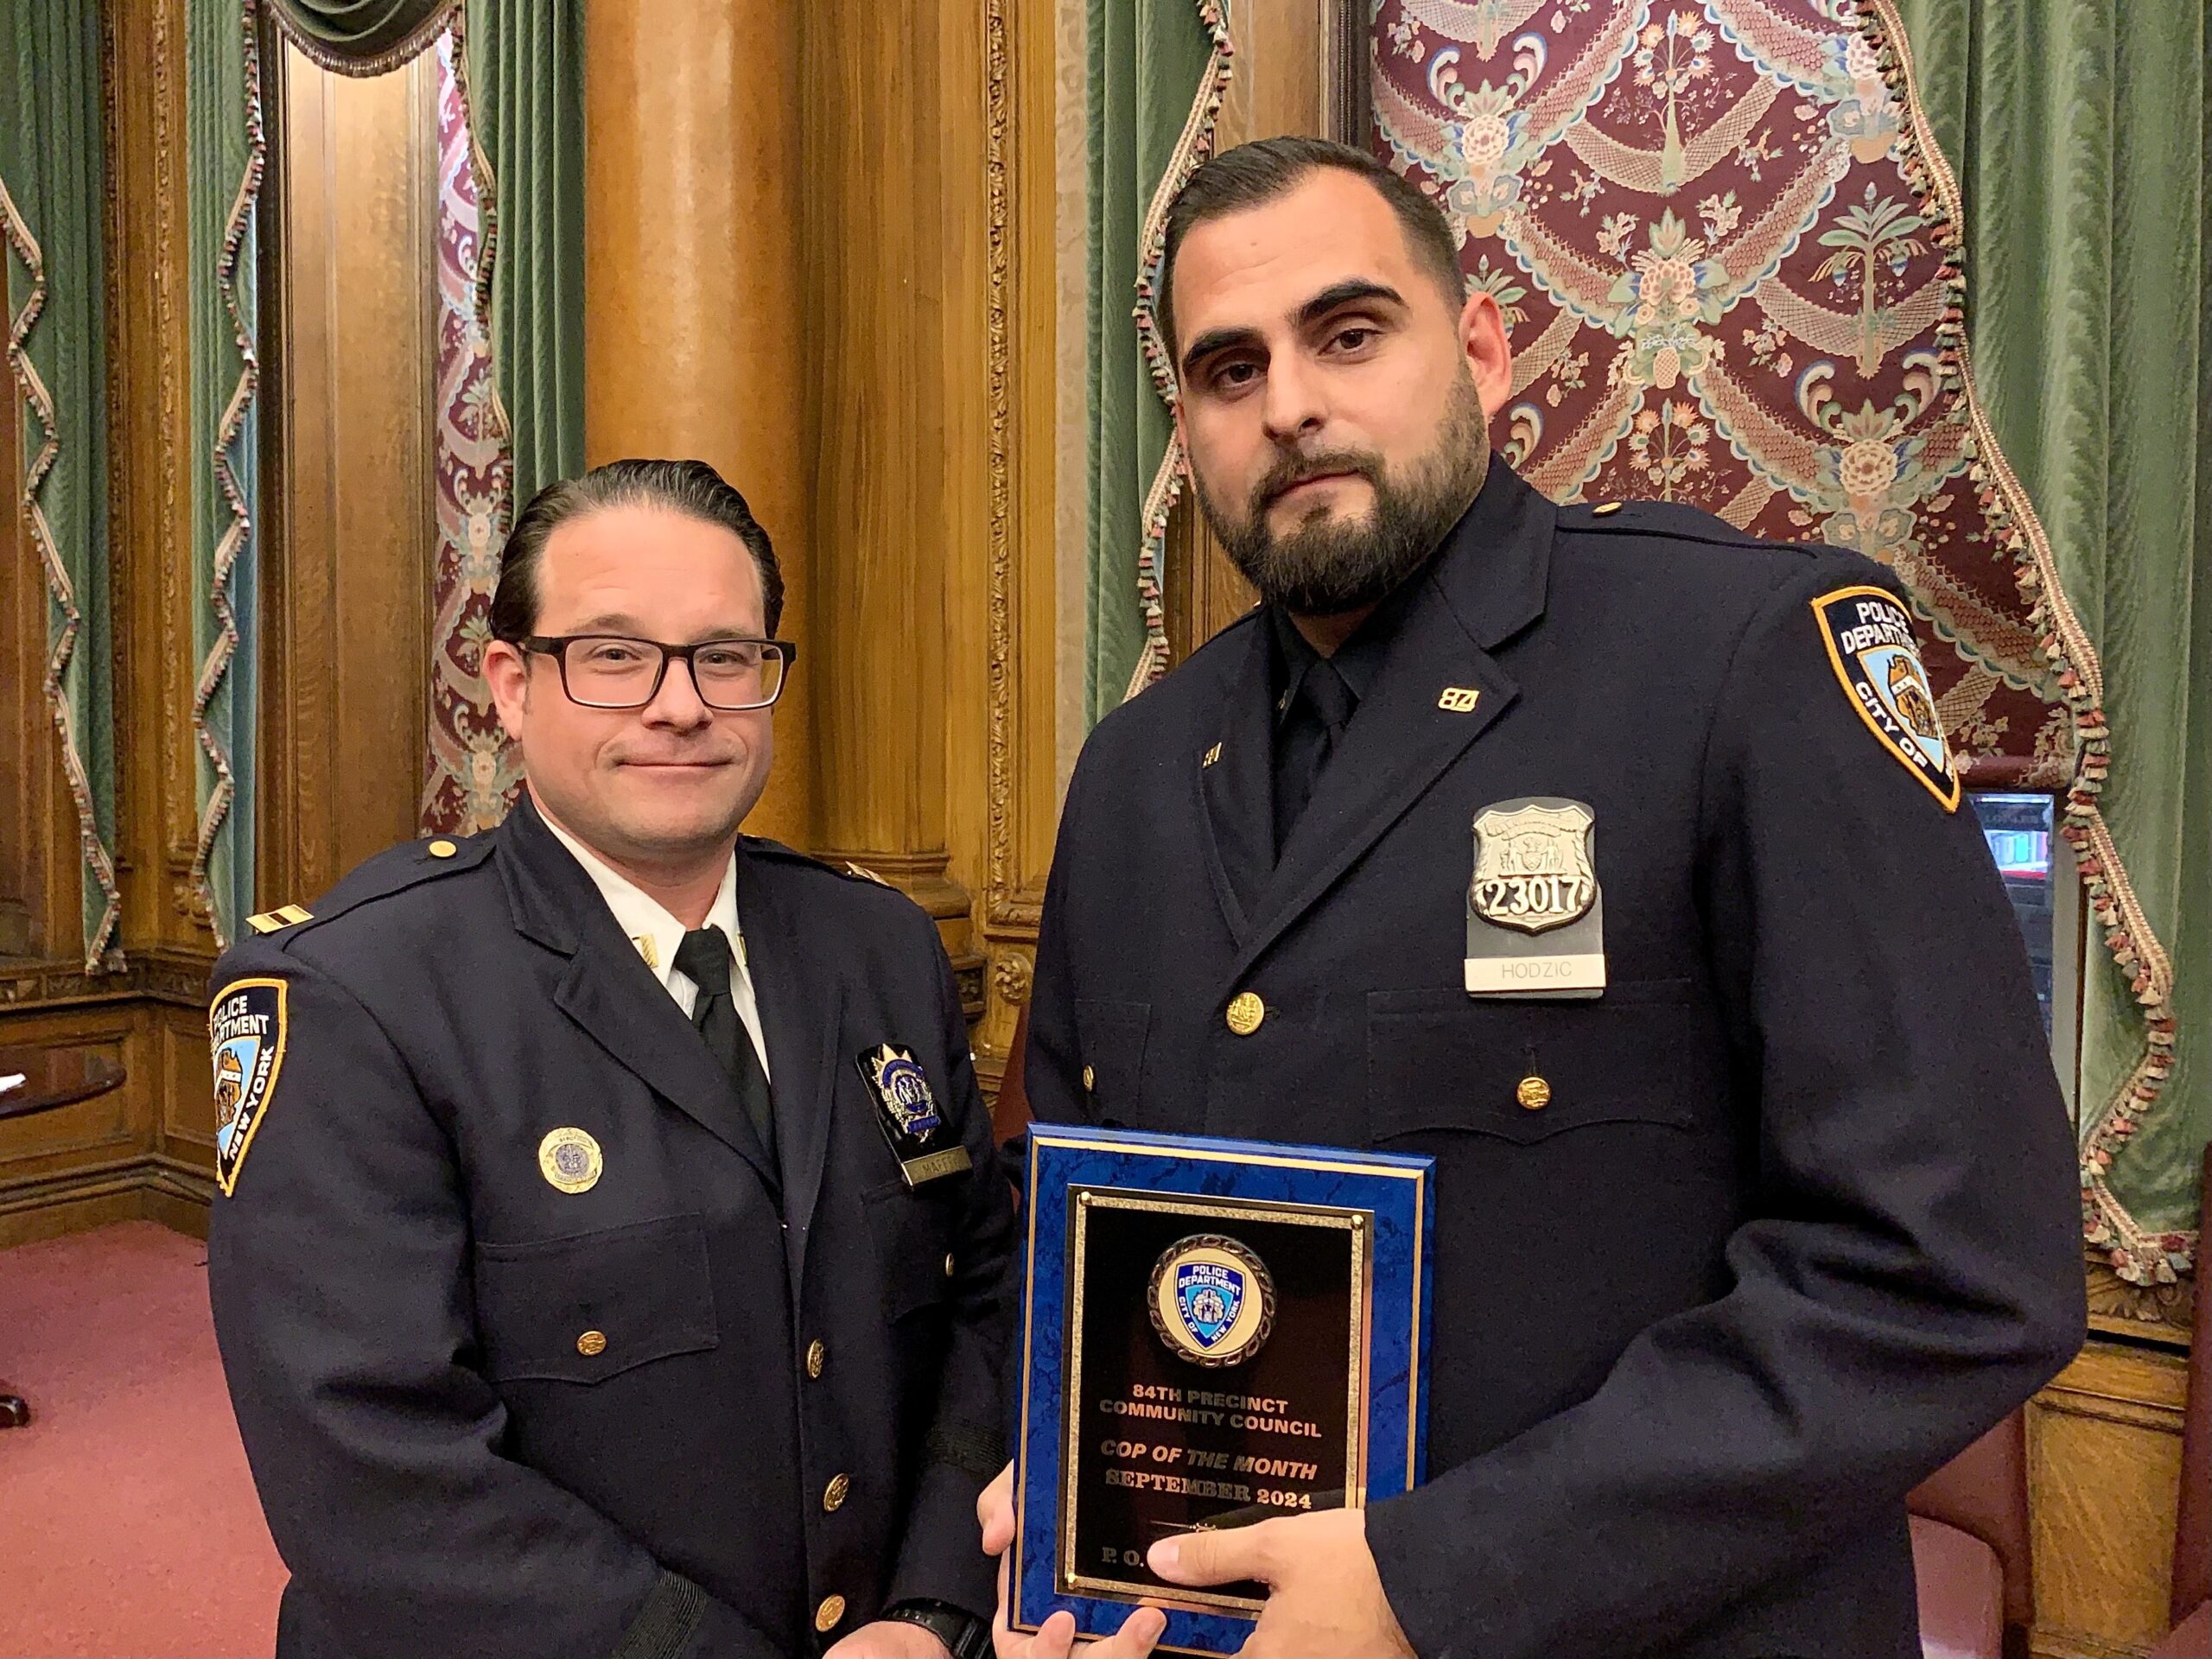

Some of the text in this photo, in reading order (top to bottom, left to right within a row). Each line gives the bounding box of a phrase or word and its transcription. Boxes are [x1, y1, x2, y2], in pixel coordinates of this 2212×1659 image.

[1855, 601, 1910, 634] POLICE
[1438, 687, 1479, 713] 84
[1855, 682, 1928, 767] CITY OF
[1484, 876, 1582, 916] 23017
[1502, 961, 1573, 979] HODZIC
[229, 1046, 275, 1160] NEW YORK
[1179, 1274, 1242, 1296] DEPARTMENT
[1192, 1265, 1229, 1280] POLICE
[1179, 1296, 1198, 1334] CITY OF
[1211, 1300, 1240, 1342] NEW YORK
[1133, 1383, 1288, 1414] 84TH PRECINCT
[1099, 1399, 1322, 1438] COMMUNITY COUNCIL
[1101, 1439, 1318, 1479] COP OF THE MONTH
[1105, 1468, 1312, 1510] SEPTEMBER 2024
